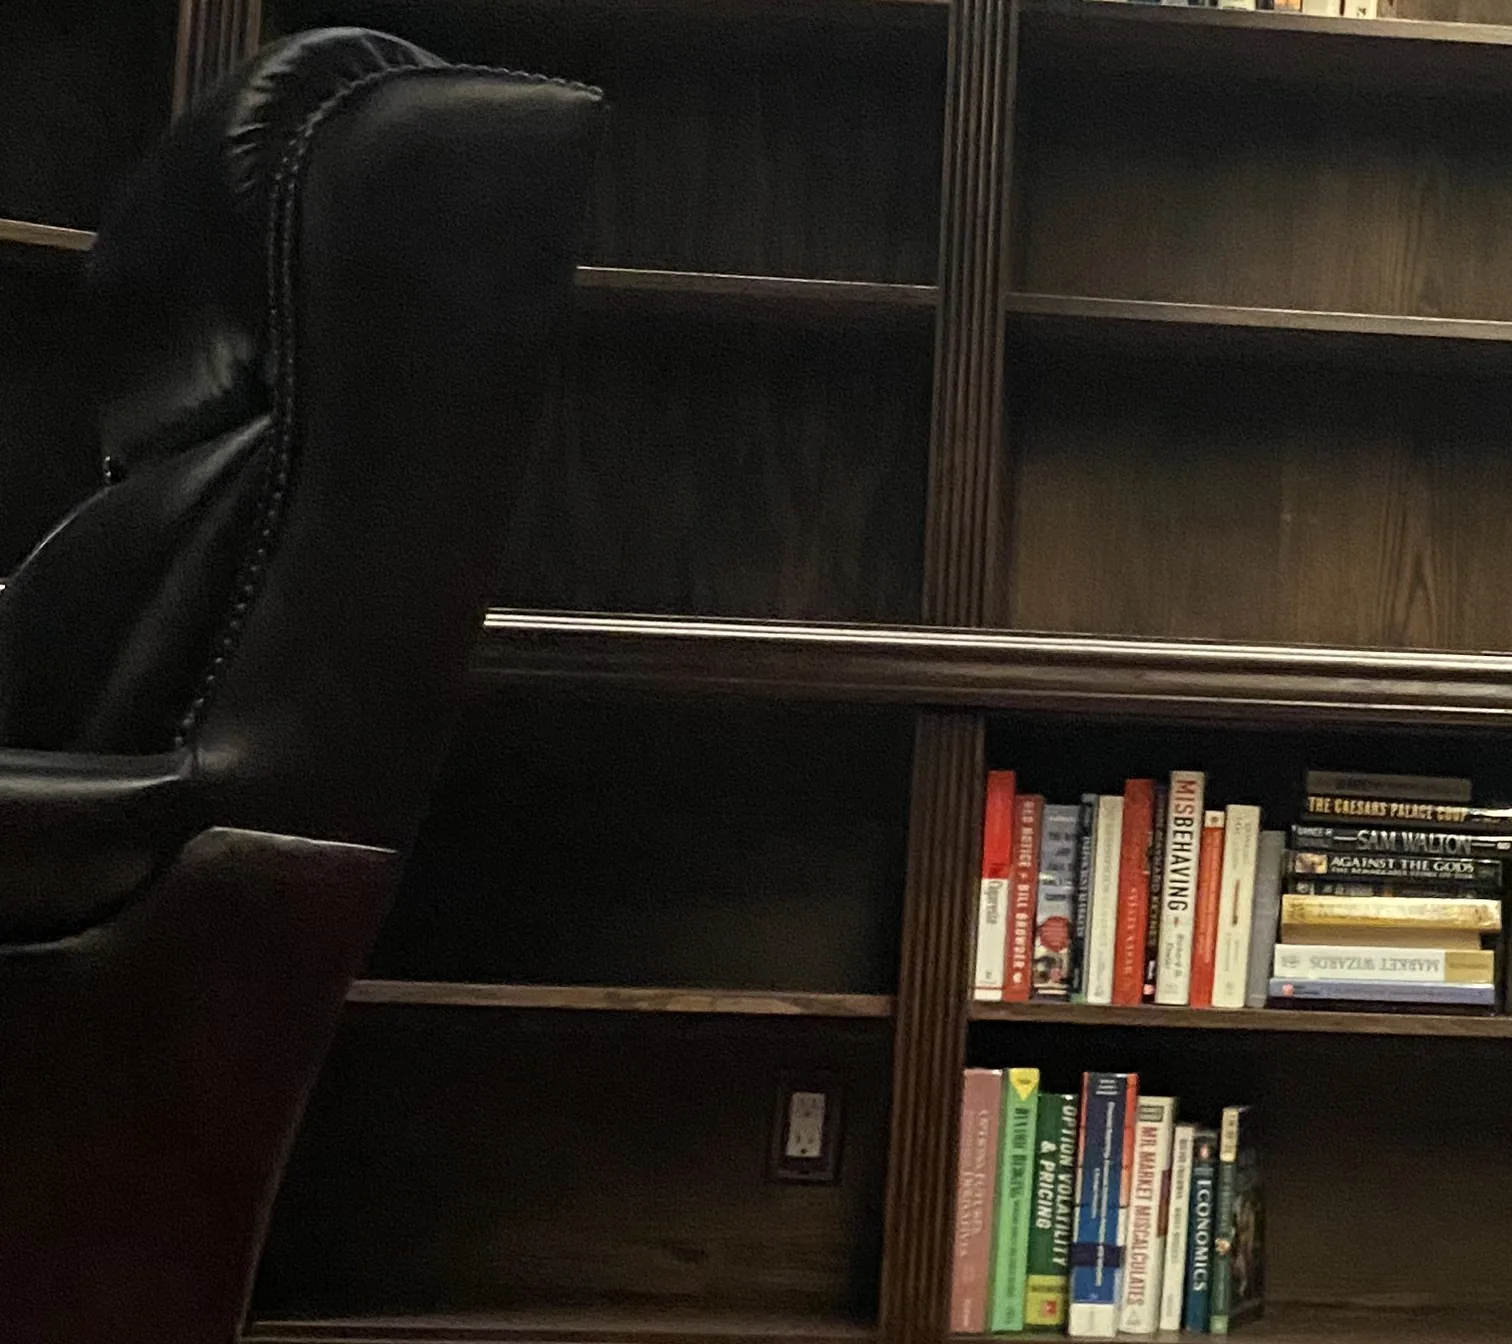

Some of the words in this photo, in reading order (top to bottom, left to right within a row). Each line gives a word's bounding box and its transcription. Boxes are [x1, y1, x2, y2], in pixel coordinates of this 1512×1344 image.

[1308, 796, 1330, 813] THE
[1334, 798, 1387, 816] CAESARS
[1390, 802, 1433, 820] PALACE
[1018, 826, 1034, 868] NOTICE
[1167, 778, 1197, 912] MISBEHAVING
[1357, 829, 1397, 852] SAM
[1401, 831, 1473, 855] WALTON
[1331, 856, 1395, 870] AGAINST
[1401, 859, 1431, 872] THE
[1433, 861, 1475, 874] GODS
[1015, 883, 1030, 909] BILL
[1309, 954, 1375, 970] WIZARDS
[1380, 957, 1440, 973] MARKET
[1039, 1139, 1057, 1154] &
[1058, 1104, 1078, 1167] OPTION
[1135, 1150, 1157, 1202] MARKET
[1033, 1158, 1056, 1229] PRICING
[1051, 1172, 1073, 1266] VOLATILITY
[1126, 1204, 1153, 1307] MISCALCULATES
